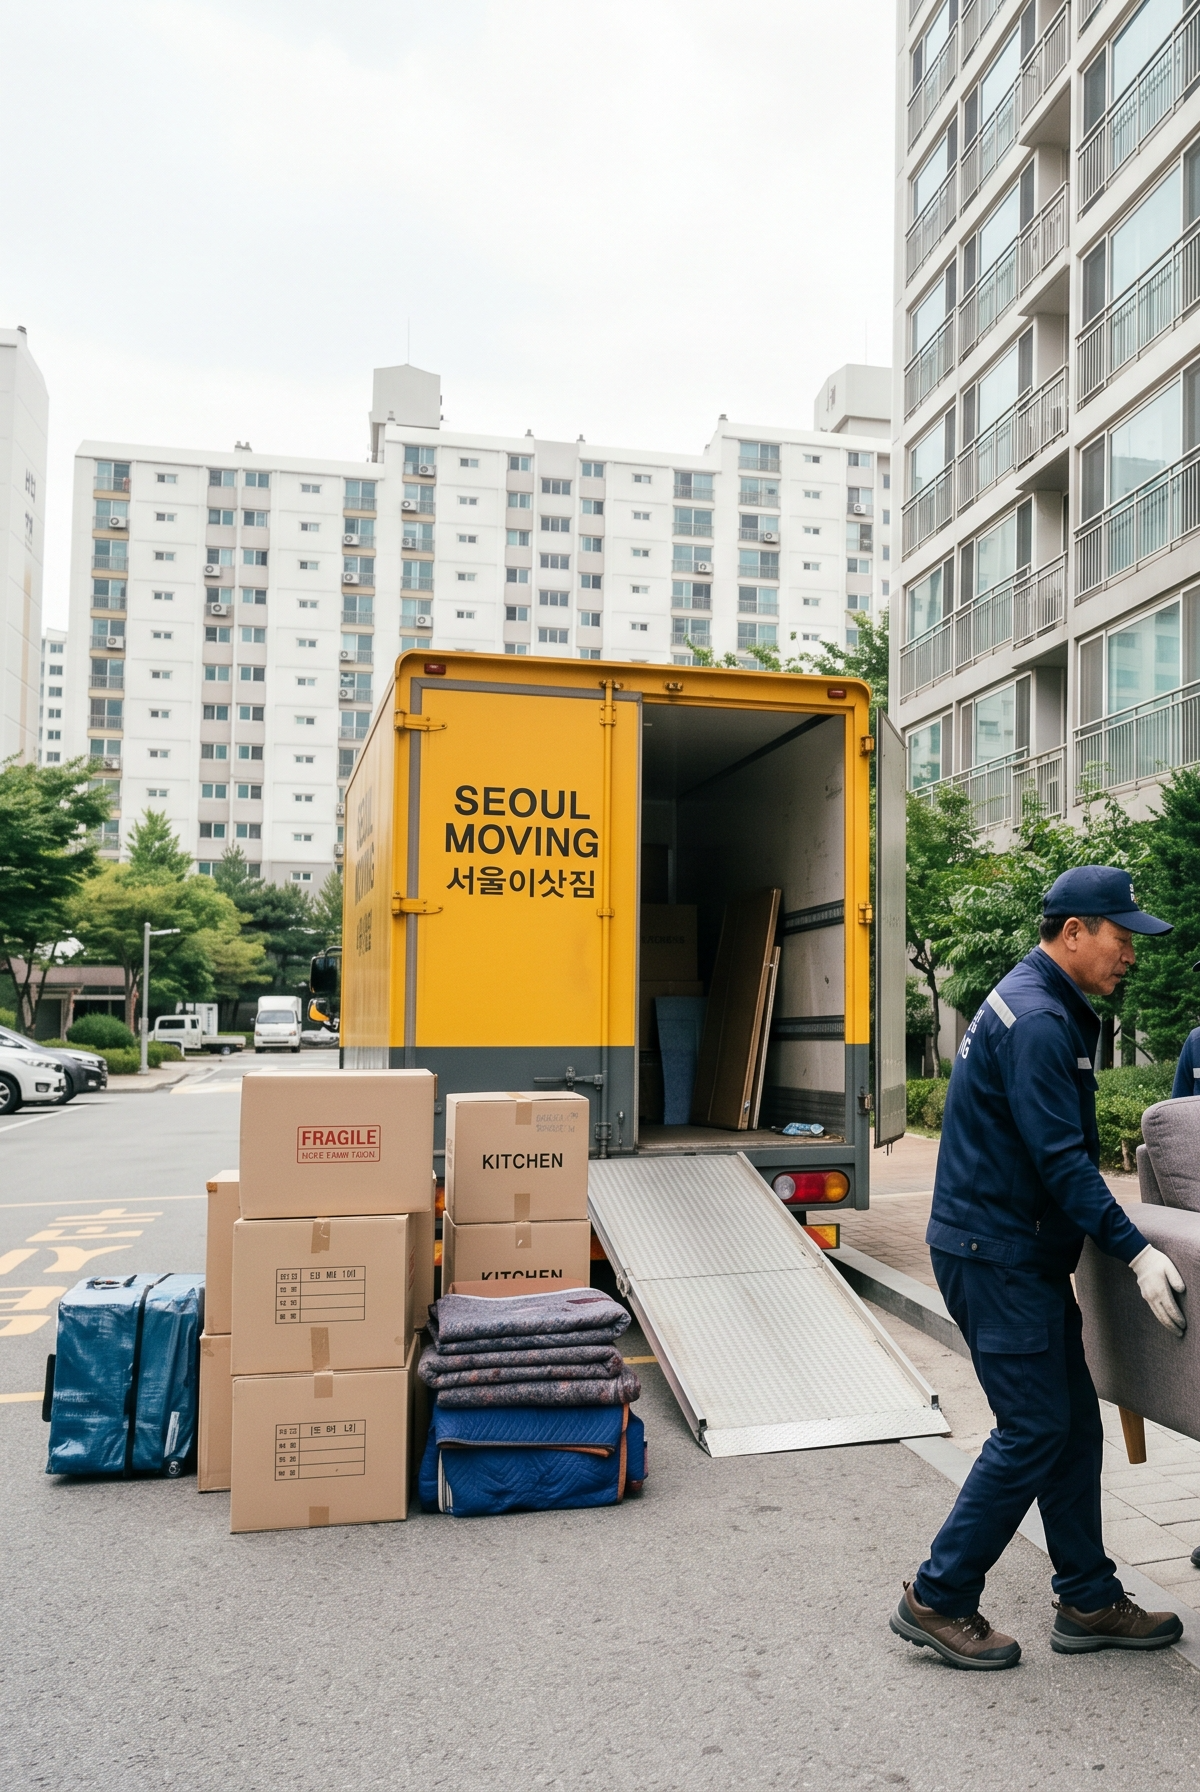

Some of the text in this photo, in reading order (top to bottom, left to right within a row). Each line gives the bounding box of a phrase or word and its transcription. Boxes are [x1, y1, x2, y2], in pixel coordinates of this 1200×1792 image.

[454, 784, 591, 820] SEOUL
[445, 822, 600, 858] MOVING
[446, 865, 596, 899] 서울이삿짐
[302, 1129, 377, 1146] FRAGILE
[482, 1153, 564, 1170] KITCHEN
